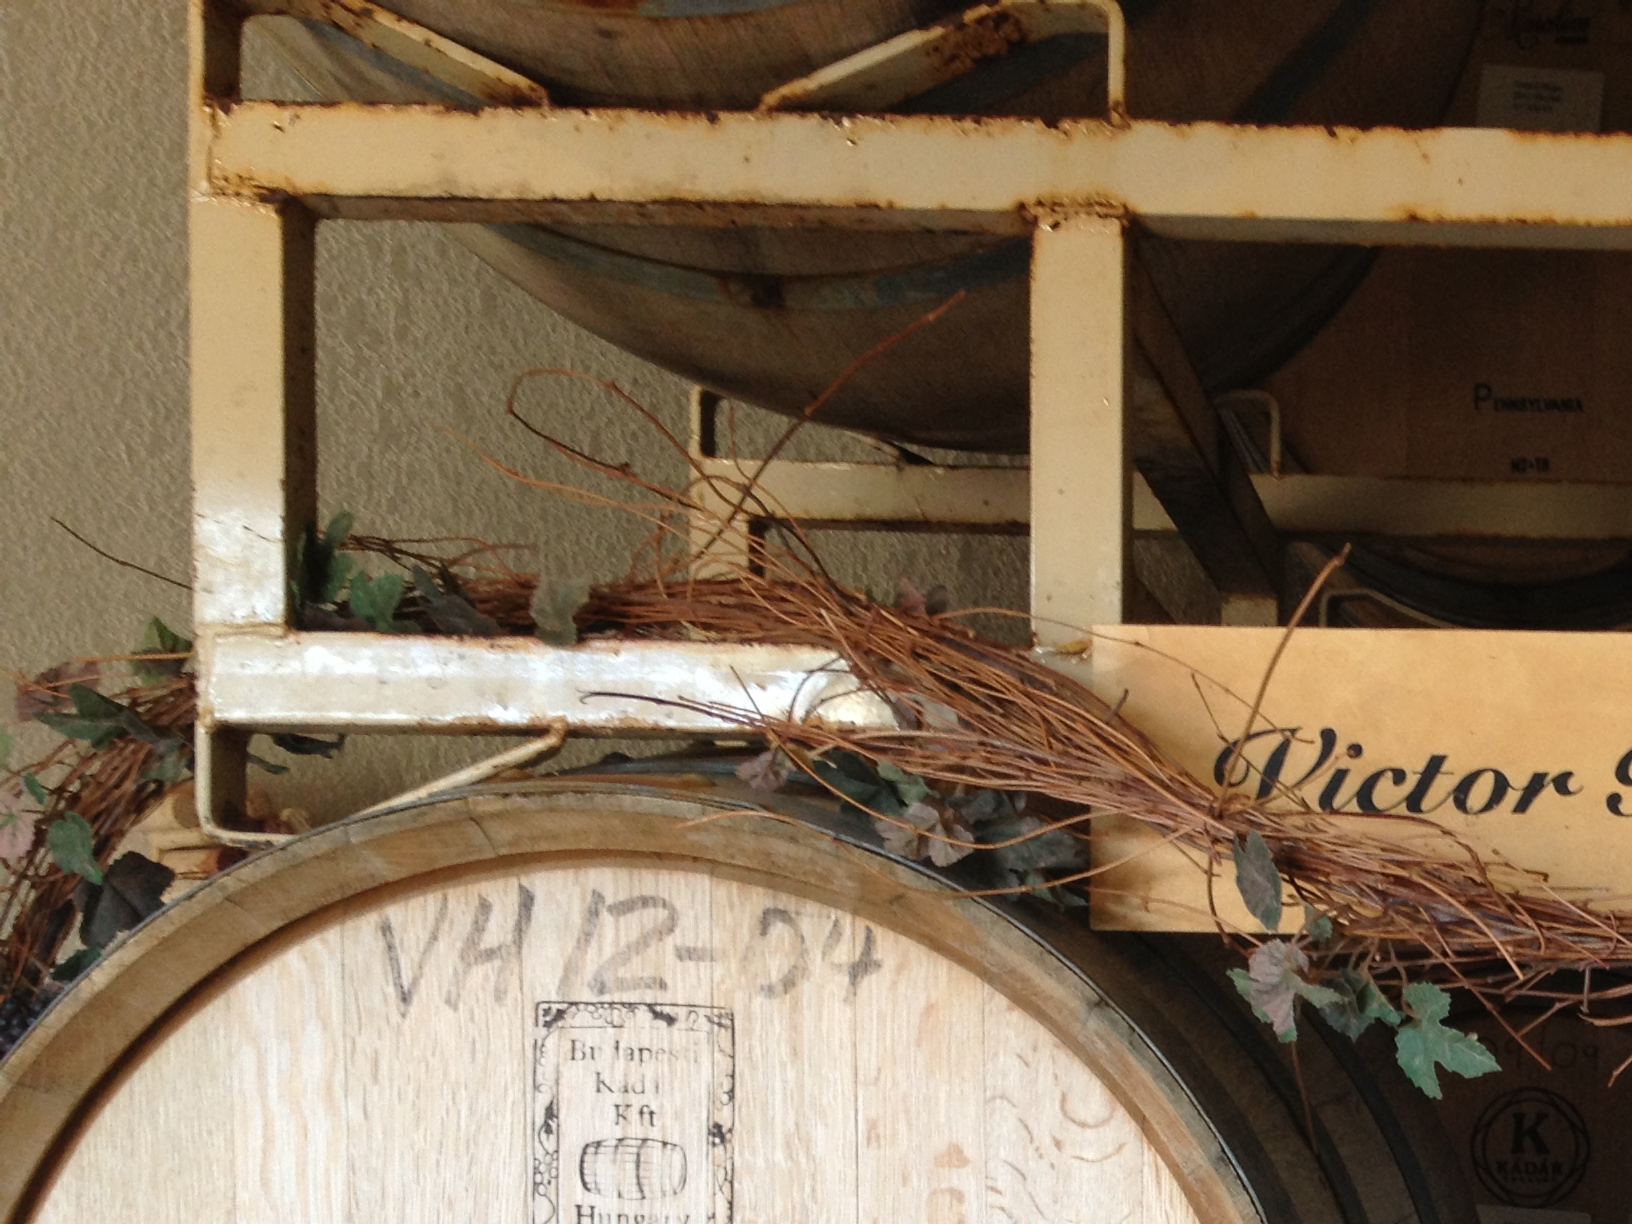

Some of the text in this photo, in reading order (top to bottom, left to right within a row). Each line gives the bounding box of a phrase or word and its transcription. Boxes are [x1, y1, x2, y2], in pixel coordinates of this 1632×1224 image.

[1213, 726, 1583, 815] Victor
[614, 1103, 657, 1128] Kft
[1511, 1112, 1550, 1154] K
